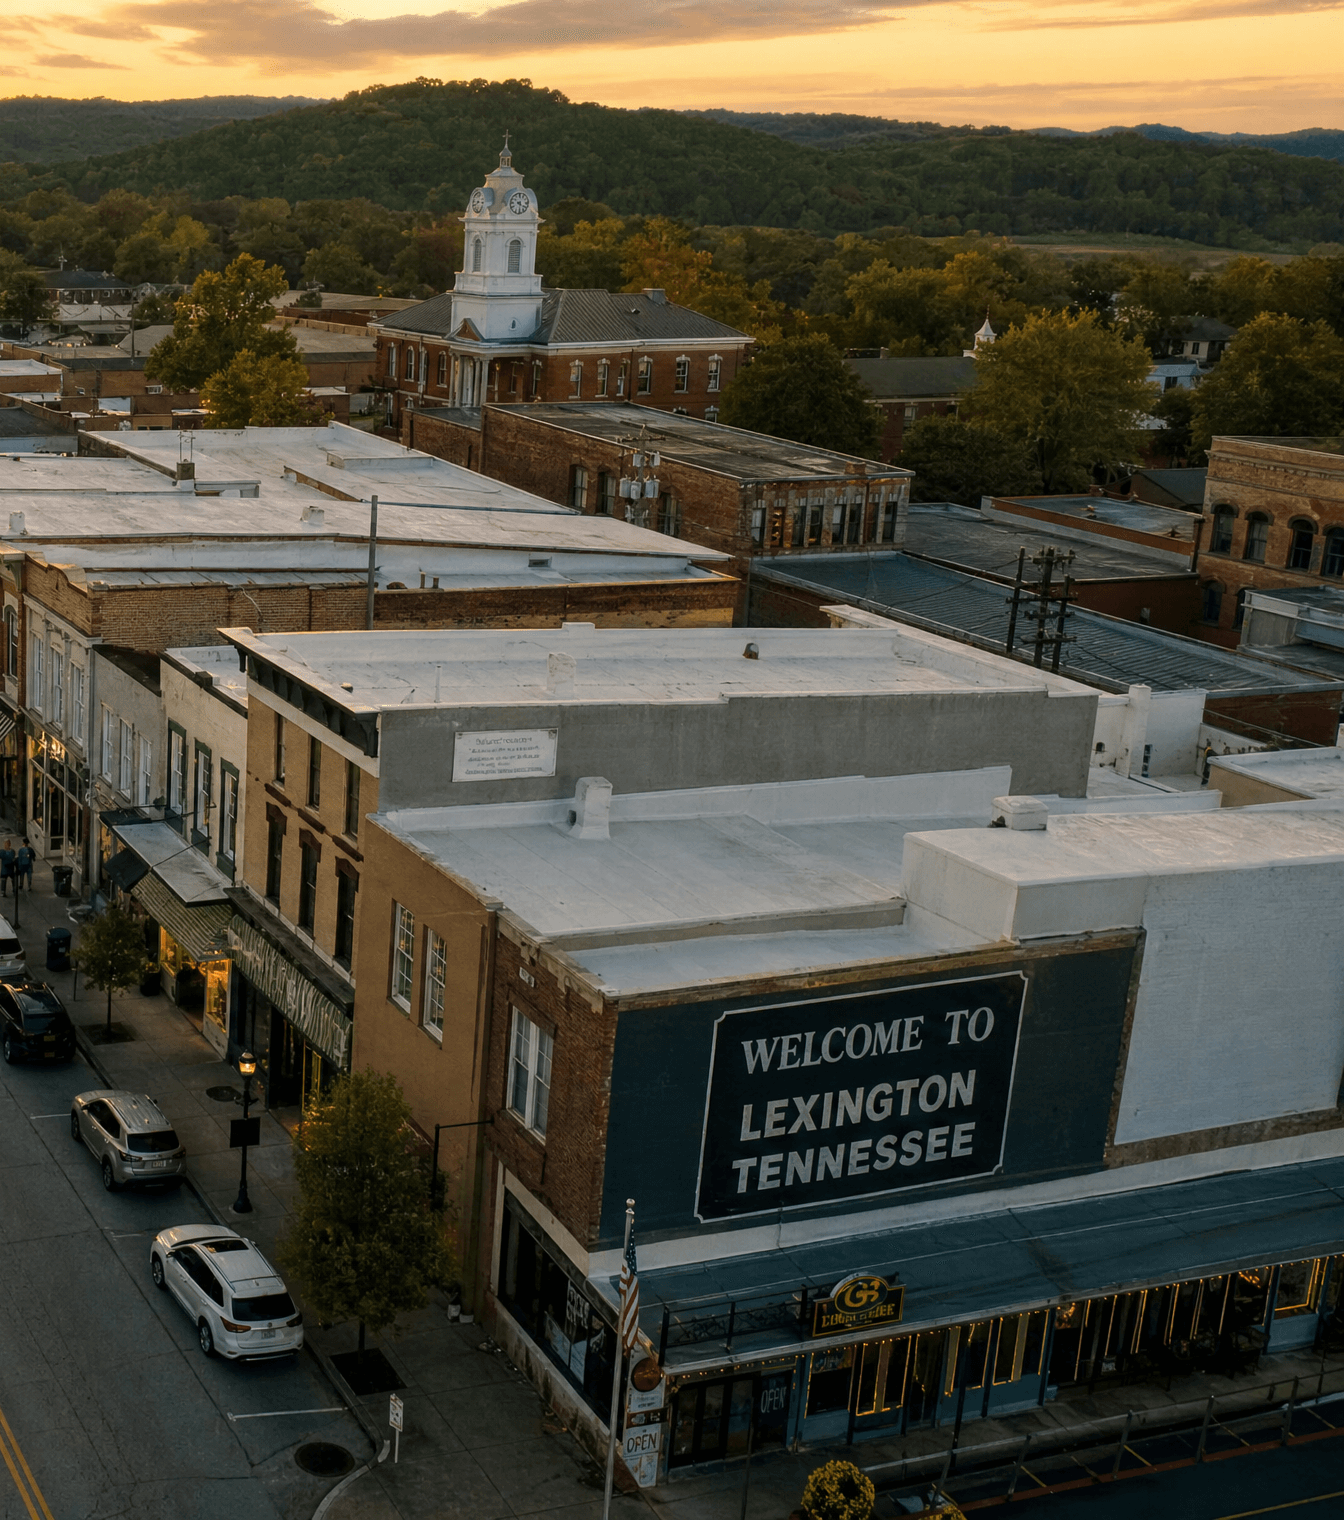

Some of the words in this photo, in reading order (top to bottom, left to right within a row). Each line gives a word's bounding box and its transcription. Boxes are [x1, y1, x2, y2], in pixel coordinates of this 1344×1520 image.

[741, 1015, 925, 1074] WELCOME
[944, 1006, 995, 1045] TO
[739, 1069, 976, 1142] LEXINGTON
[732, 1122, 976, 1194] TENNESSEE
[760, 1386, 787, 1414] OPEN
[627, 1432, 657, 1454] OPEN
